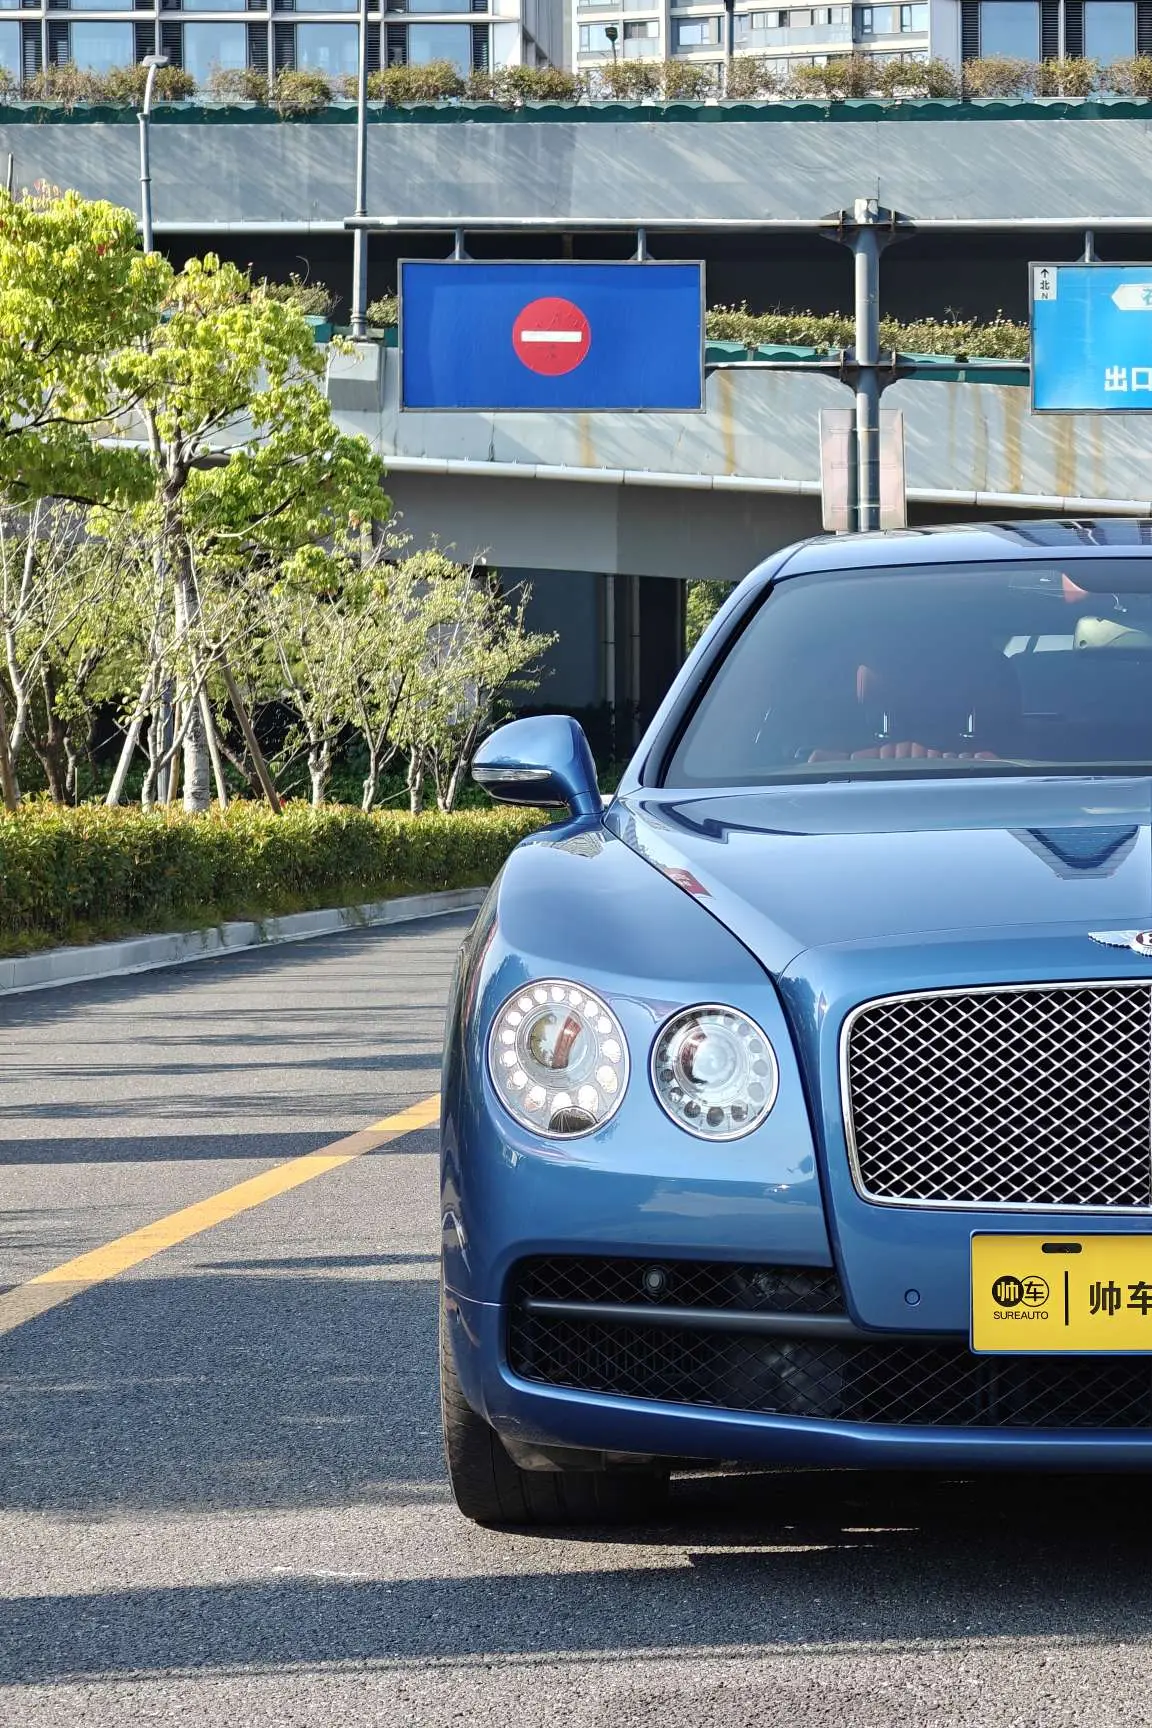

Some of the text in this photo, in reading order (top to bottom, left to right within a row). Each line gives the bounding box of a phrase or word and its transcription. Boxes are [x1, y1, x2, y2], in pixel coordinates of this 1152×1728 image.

[1039, 280, 1050, 290] 北
[993, 1278, 1048, 1306] 帅车
[993, 1310, 1049, 1320] SUREAUTO
